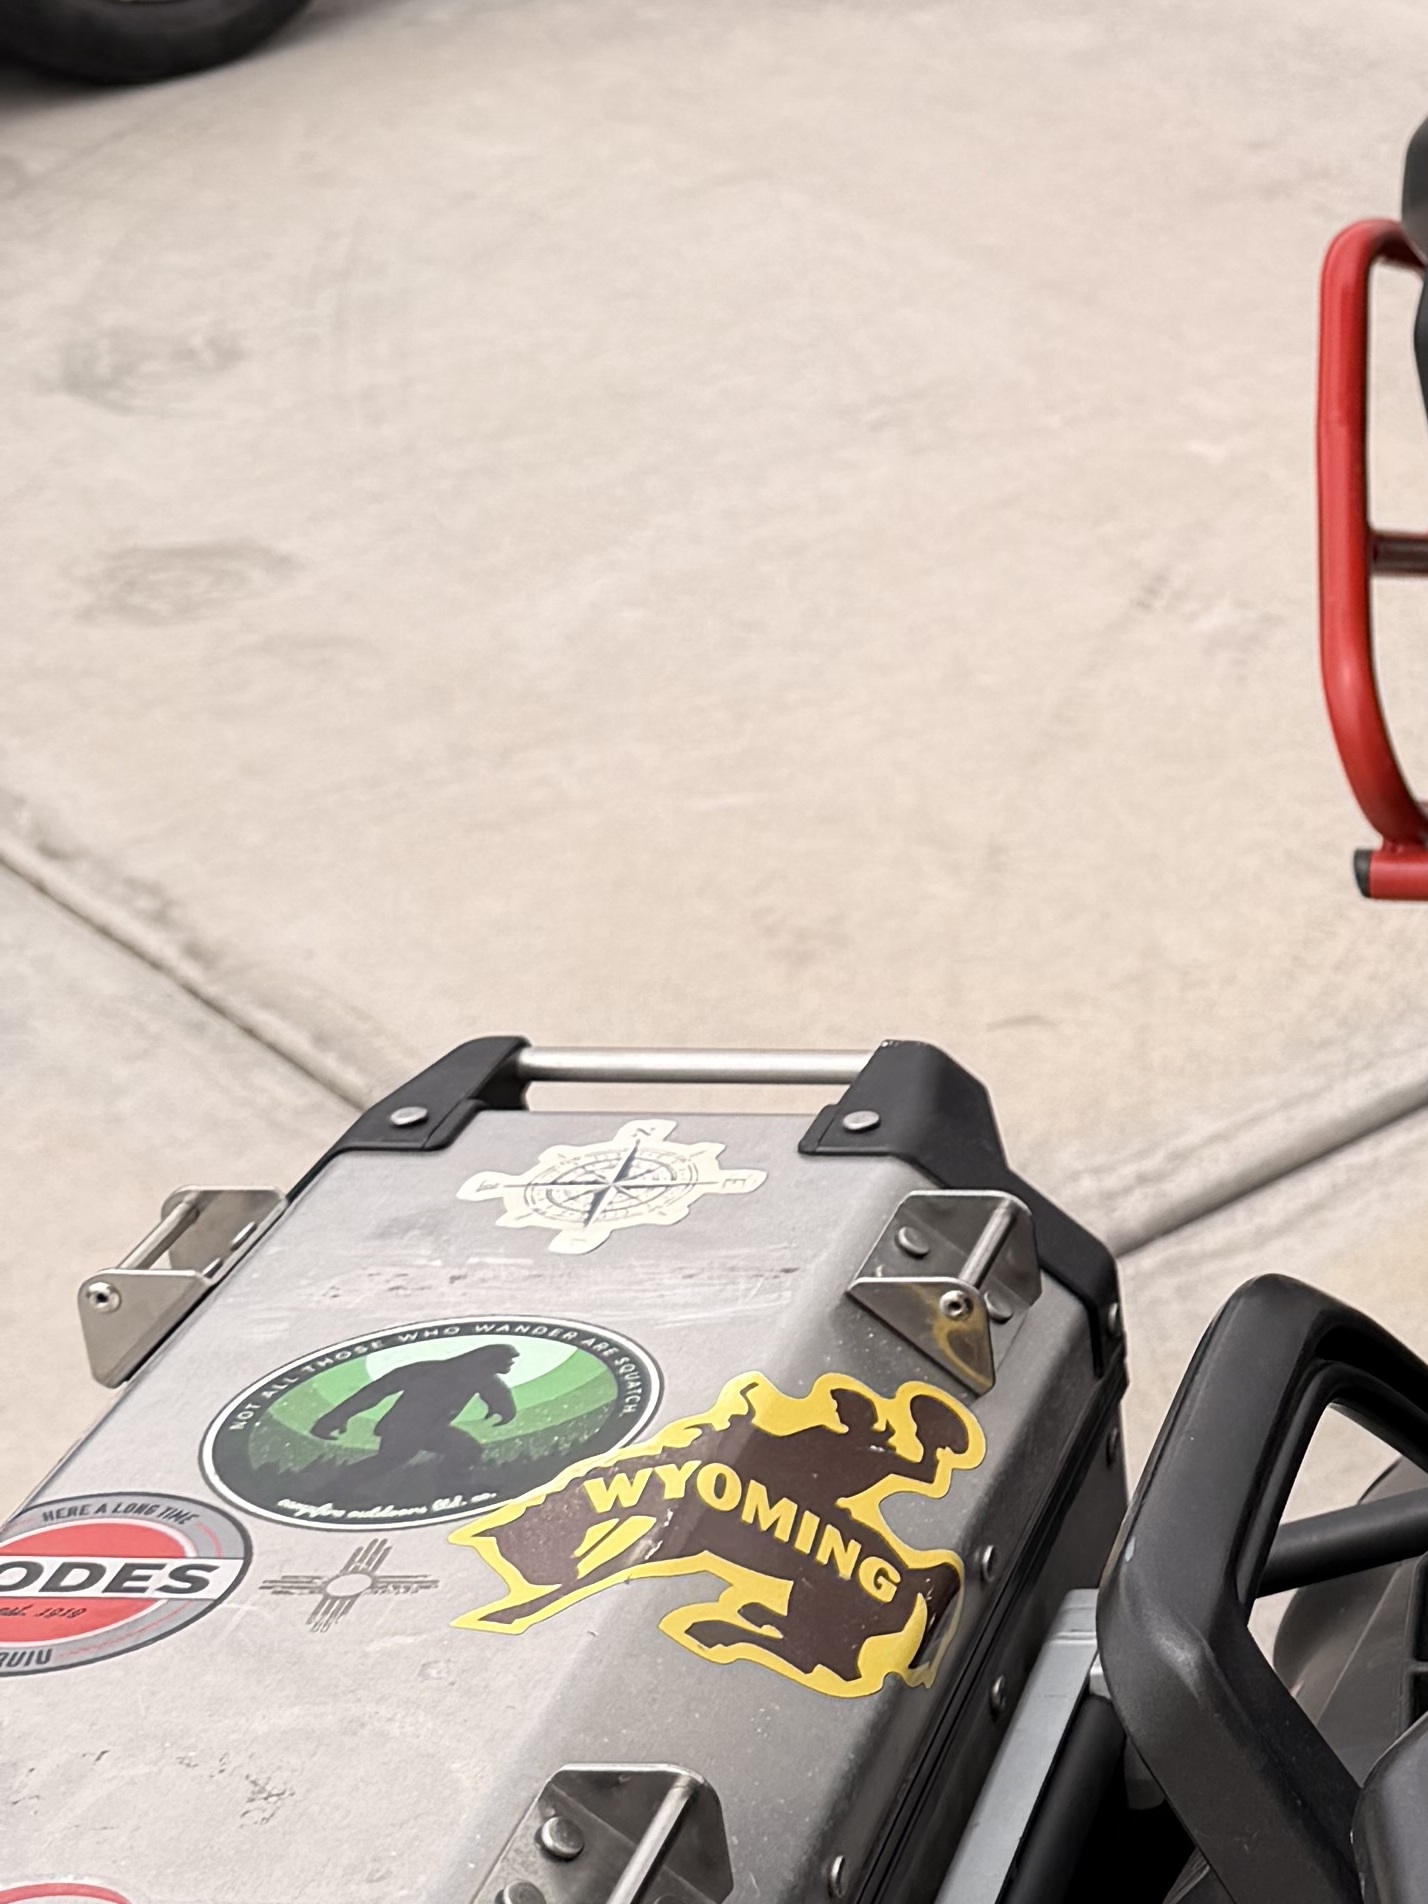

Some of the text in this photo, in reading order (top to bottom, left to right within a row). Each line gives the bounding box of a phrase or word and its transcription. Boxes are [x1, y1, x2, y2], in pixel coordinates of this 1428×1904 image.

[229, 1402, 262, 1431] NOT
[262, 1374, 299, 1399] ALL
[302, 1339, 384, 1374] THOSE
[397, 1325, 460, 1343] WHO
[473, 1322, 577, 1342] WANDER
[580, 1332, 620, 1357] ARE
[42, 1501, 200, 1526] HERE A LONG TIME
[586, 1458, 901, 1607] WYOMING
